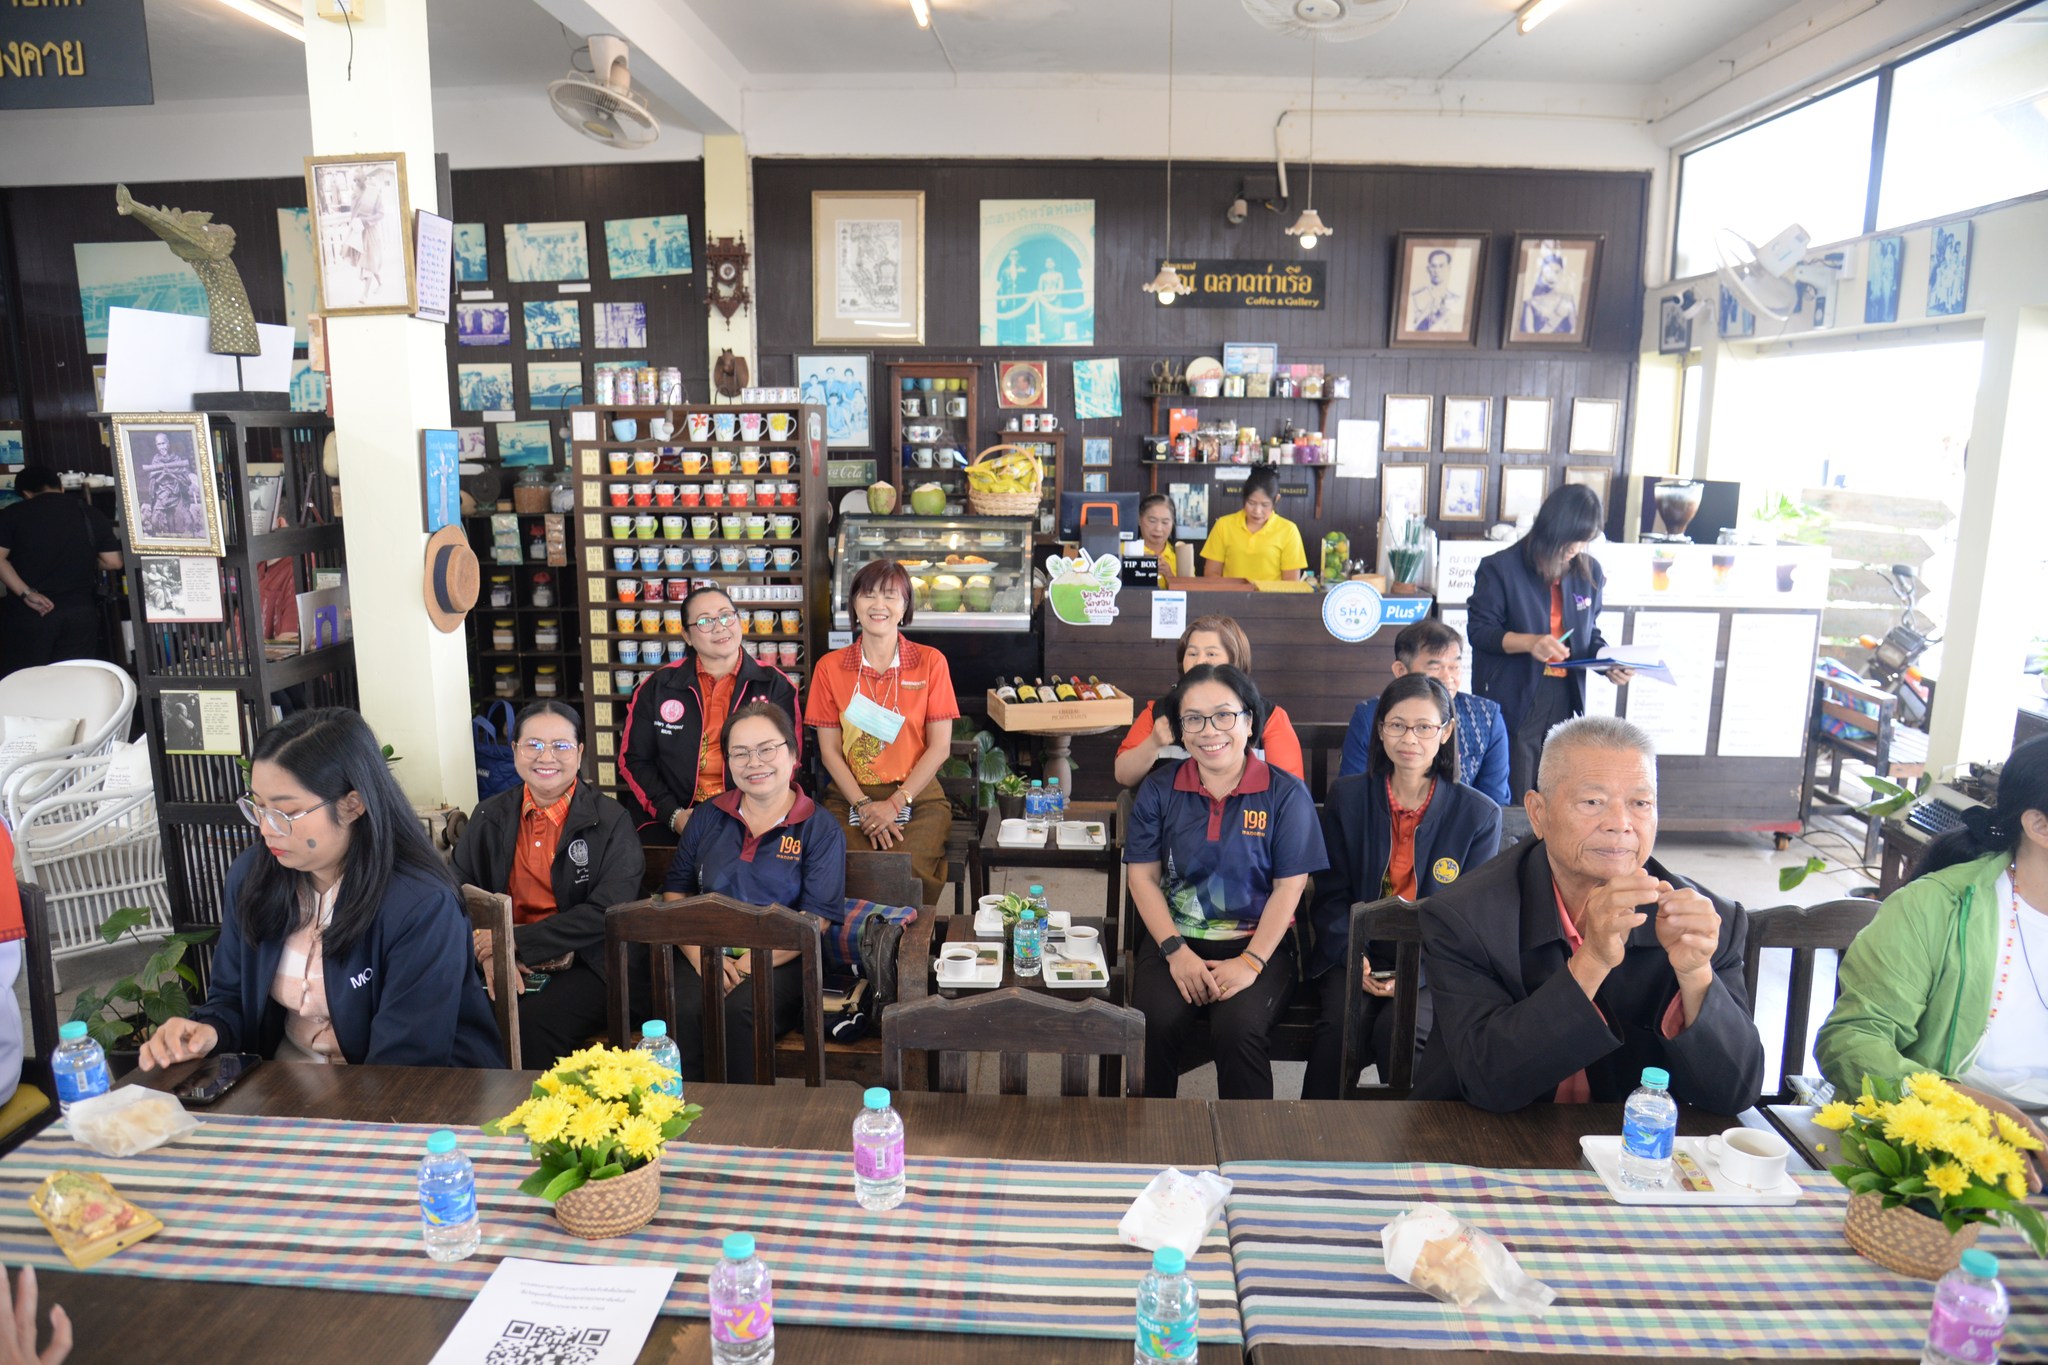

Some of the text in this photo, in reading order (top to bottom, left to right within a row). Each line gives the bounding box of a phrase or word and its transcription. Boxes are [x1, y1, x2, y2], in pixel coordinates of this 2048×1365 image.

[0, 40, 85, 77] งคาย
[1245, 296, 1320, 308] Coffee & Gallery
[1123, 560, 1157, 568] TIP BOX
[1340, 607, 1368, 616] SHA
[1243, 810, 1267, 830] 198
[779, 835, 801, 855] 198
